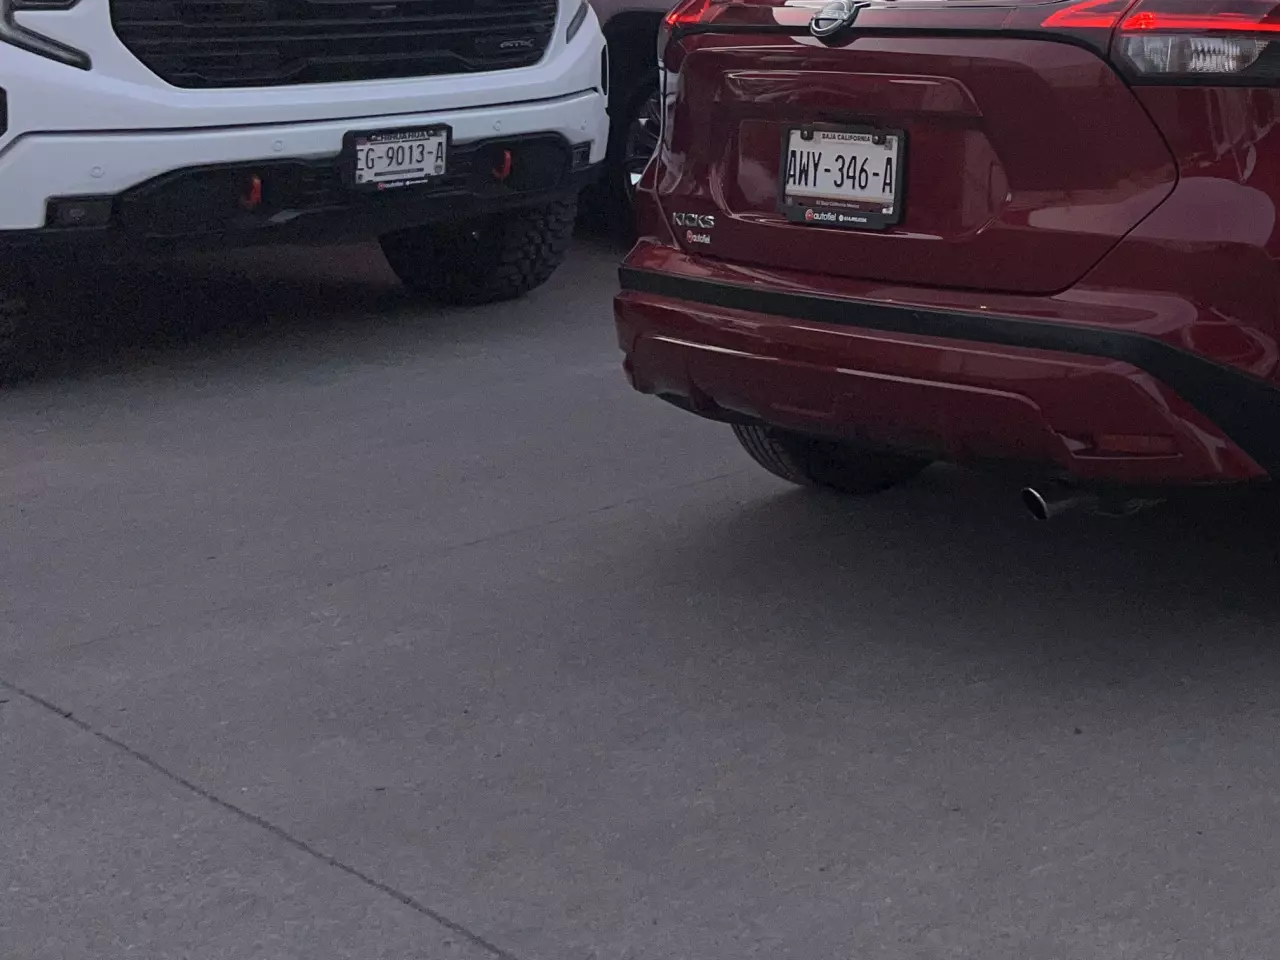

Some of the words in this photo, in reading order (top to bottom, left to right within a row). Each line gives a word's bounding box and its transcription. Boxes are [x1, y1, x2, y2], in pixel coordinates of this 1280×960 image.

[837, 134, 871, 142] CALIFORNIA
[786, 149, 893, 194] AWY-346-A
[672, 212, 715, 228] KICKS
[813, 212, 837, 221] autofiel
